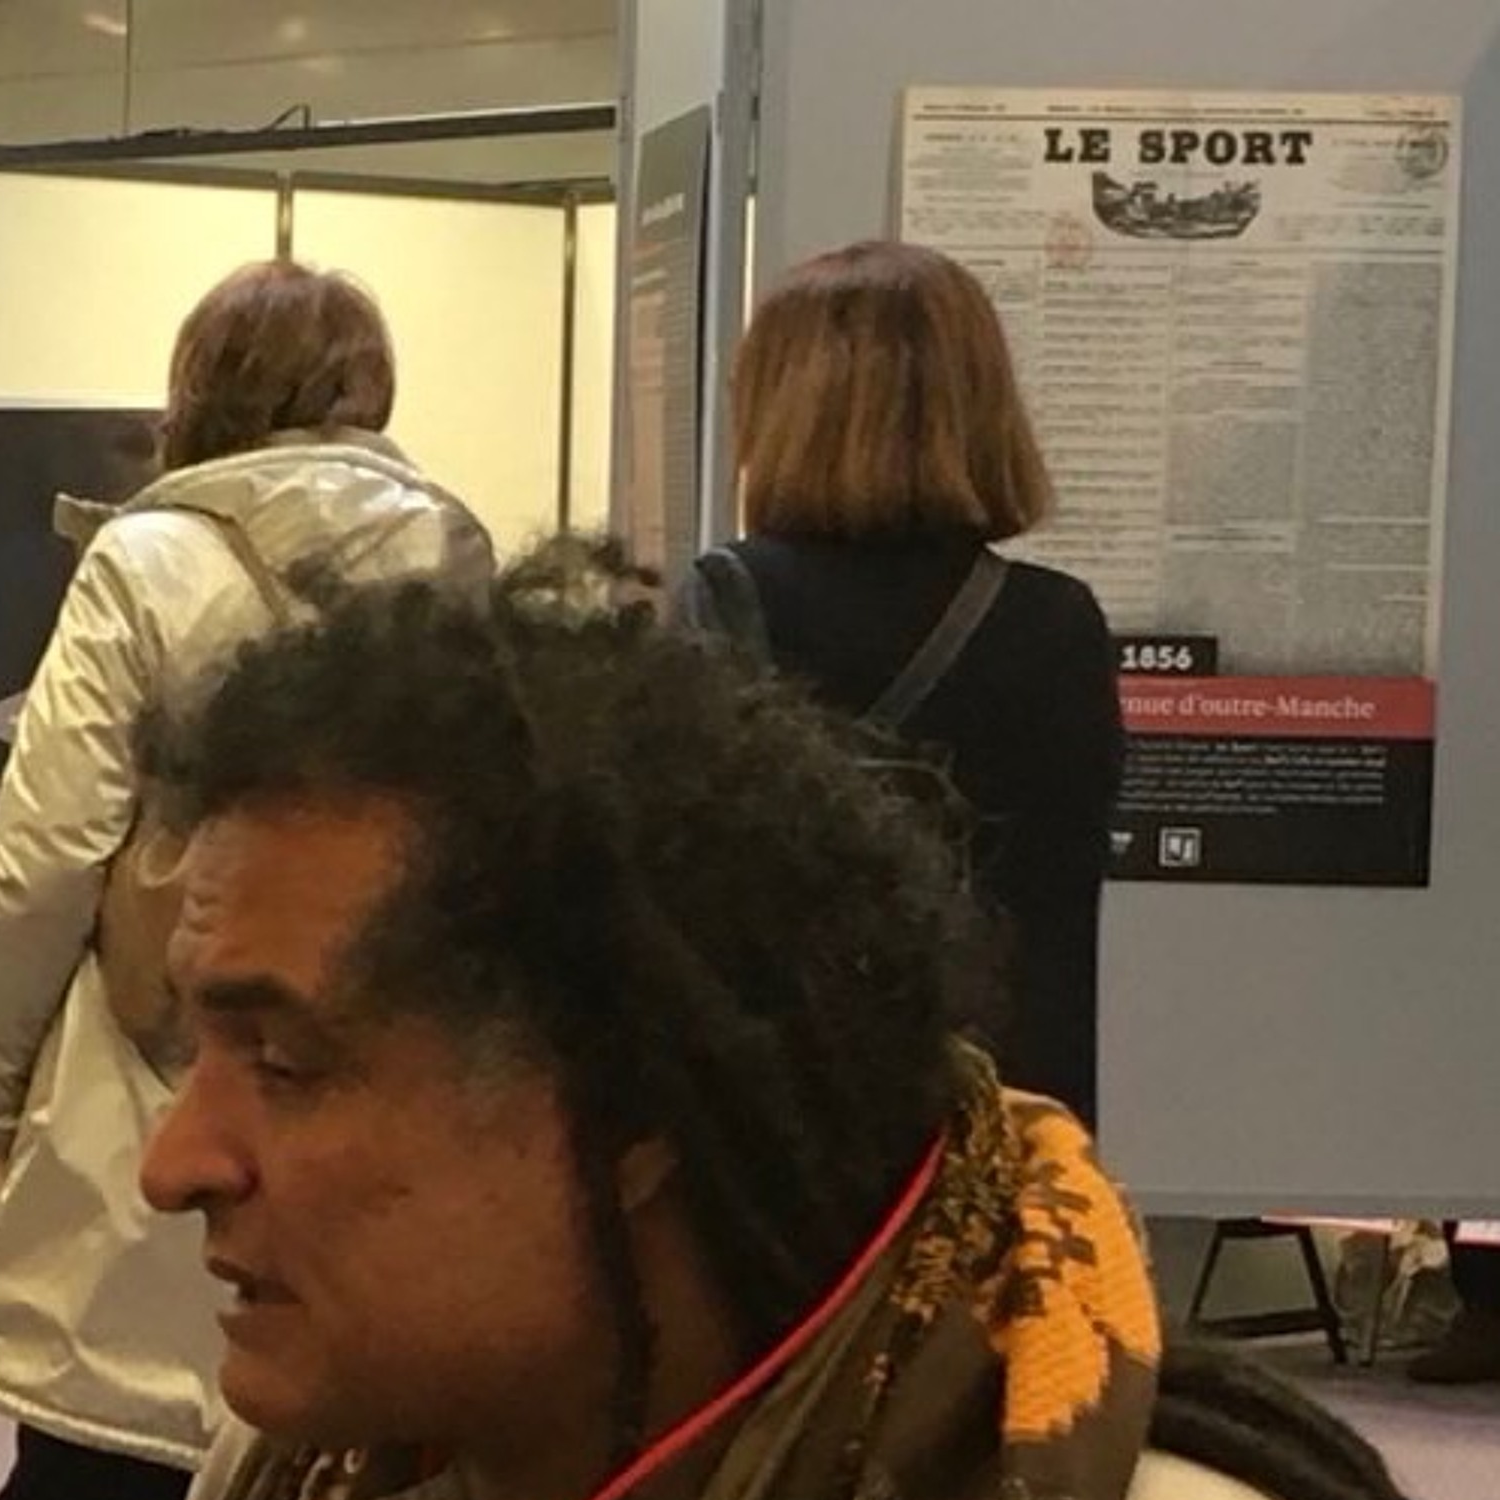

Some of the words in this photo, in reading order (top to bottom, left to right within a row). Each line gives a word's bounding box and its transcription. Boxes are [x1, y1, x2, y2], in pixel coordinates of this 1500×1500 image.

[1043, 128, 1110, 164] LE
[1139, 130, 1313, 165] SPORT
[1120, 645, 1192, 669] 1856
[1121, 697, 1174, 715] nue
[1179, 695, 1376, 719] d'outre-Manche
